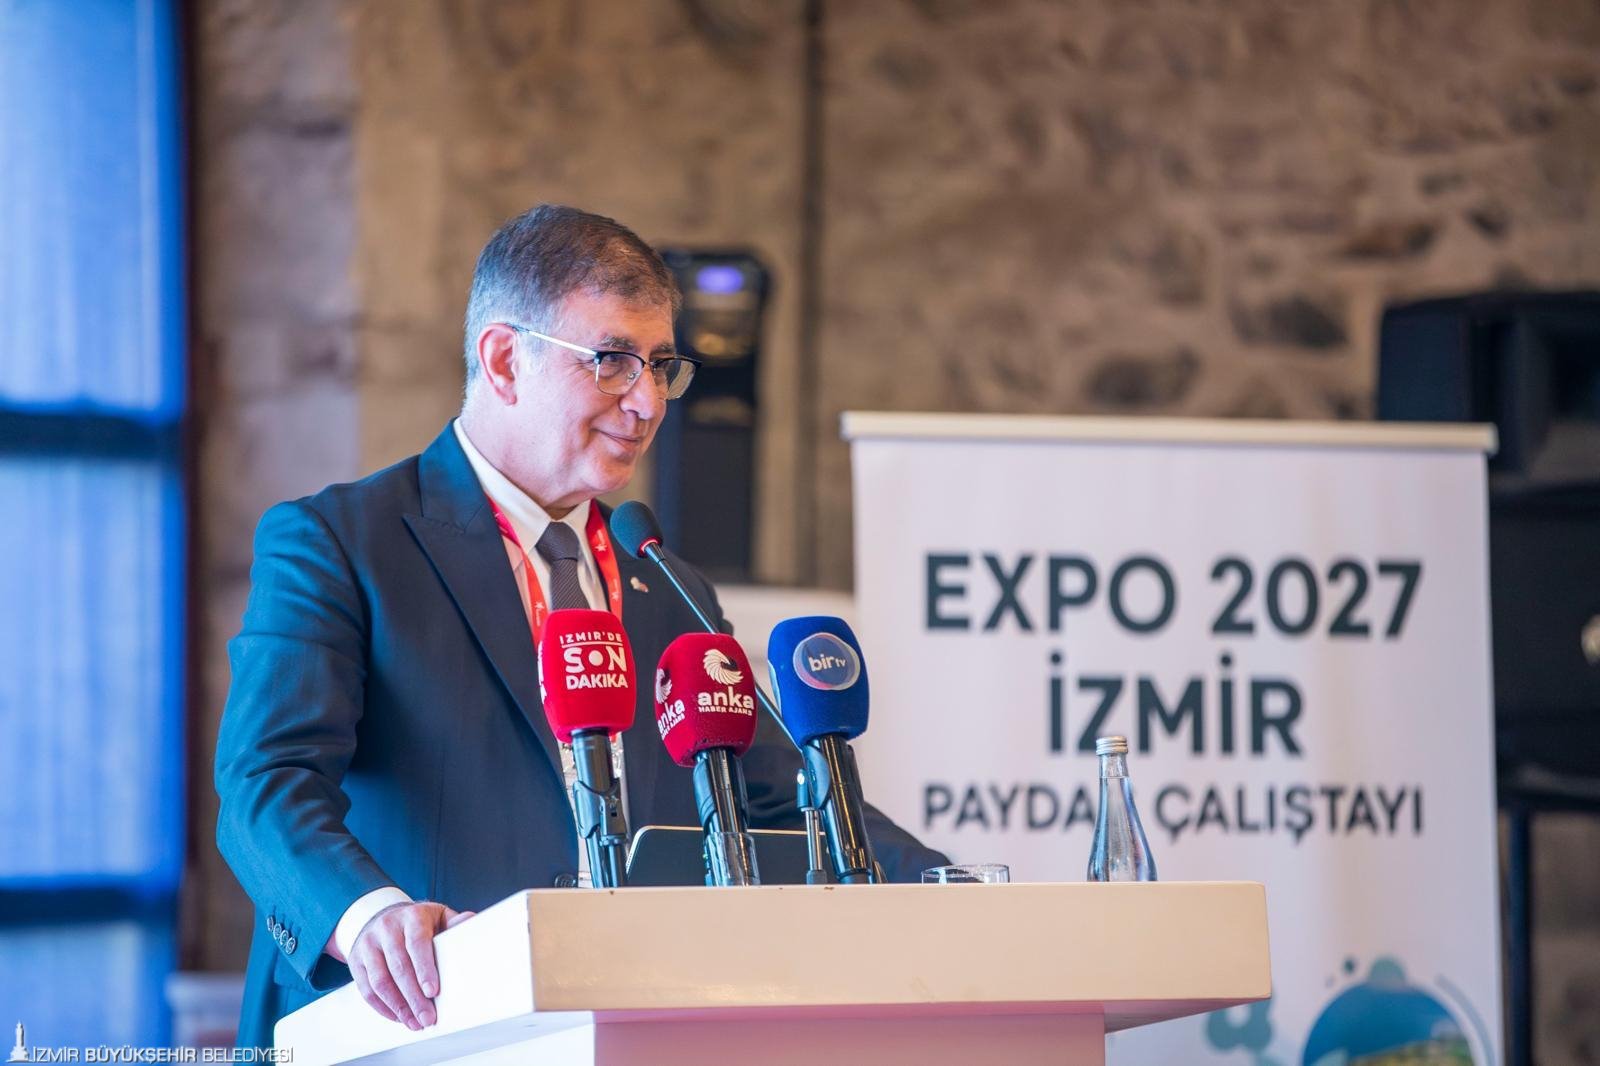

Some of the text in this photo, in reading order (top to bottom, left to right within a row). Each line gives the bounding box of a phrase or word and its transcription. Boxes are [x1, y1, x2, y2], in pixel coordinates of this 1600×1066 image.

[922, 552, 1423, 638] EXPO 2027
[563, 646, 628, 674] SON
[808, 653, 846, 672] bir tv
[566, 673, 629, 690] DAKIKA
[697, 686, 755, 710] anka
[1047, 650, 1305, 757] İZMİR
[922, 783, 1424, 843] PAYDA ÇALIŞTAYI
